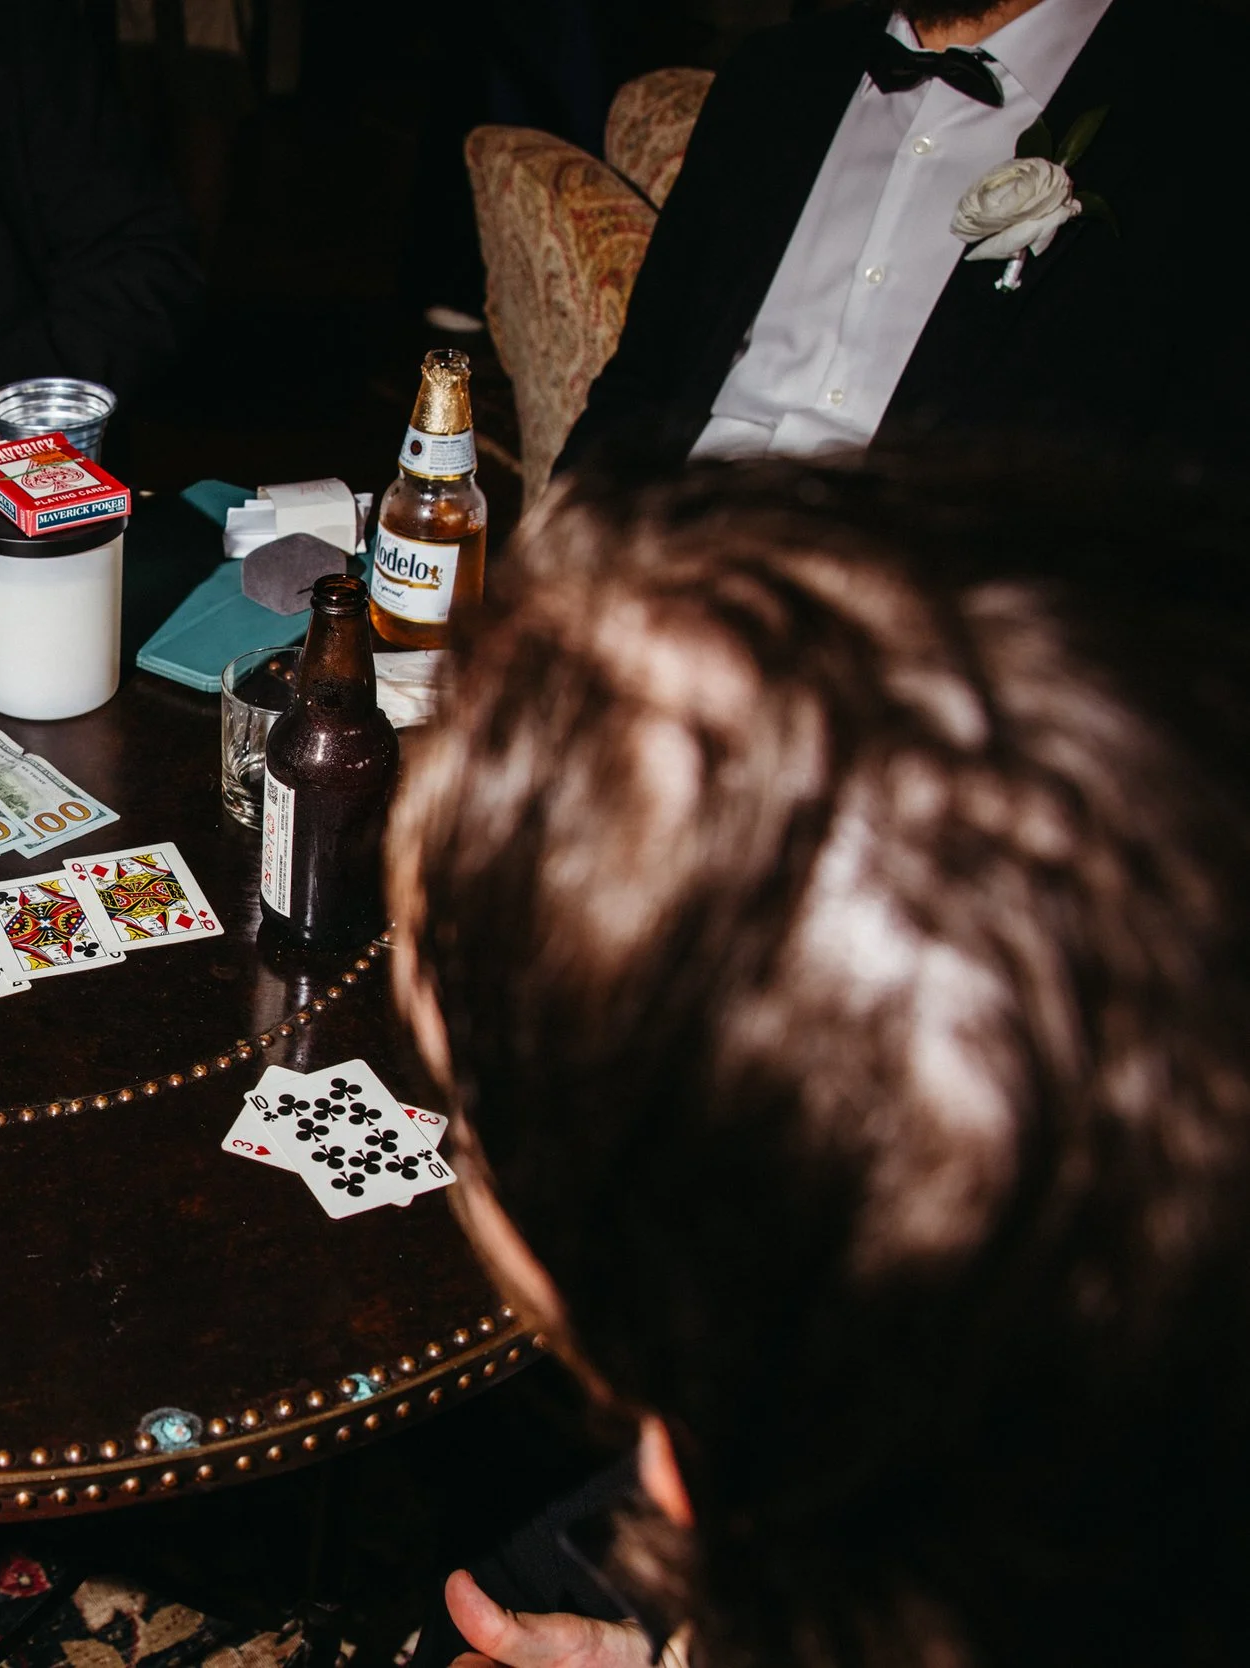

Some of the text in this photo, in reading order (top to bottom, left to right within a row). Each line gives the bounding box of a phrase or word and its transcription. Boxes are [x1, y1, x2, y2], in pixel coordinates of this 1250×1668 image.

[34, 485, 112, 506] PLAYING CARDS
[39, 506, 90, 524] MAVERICK
[91, 498, 125, 513] POKER
[71, 862, 85, 874] Q
[202, 919, 216, 931] Q
[249, 1094, 270, 1112] 10
[418, 1112, 441, 1126] 3
[232, 1138, 255, 1152] 3
[427, 1161, 451, 1180] 10
